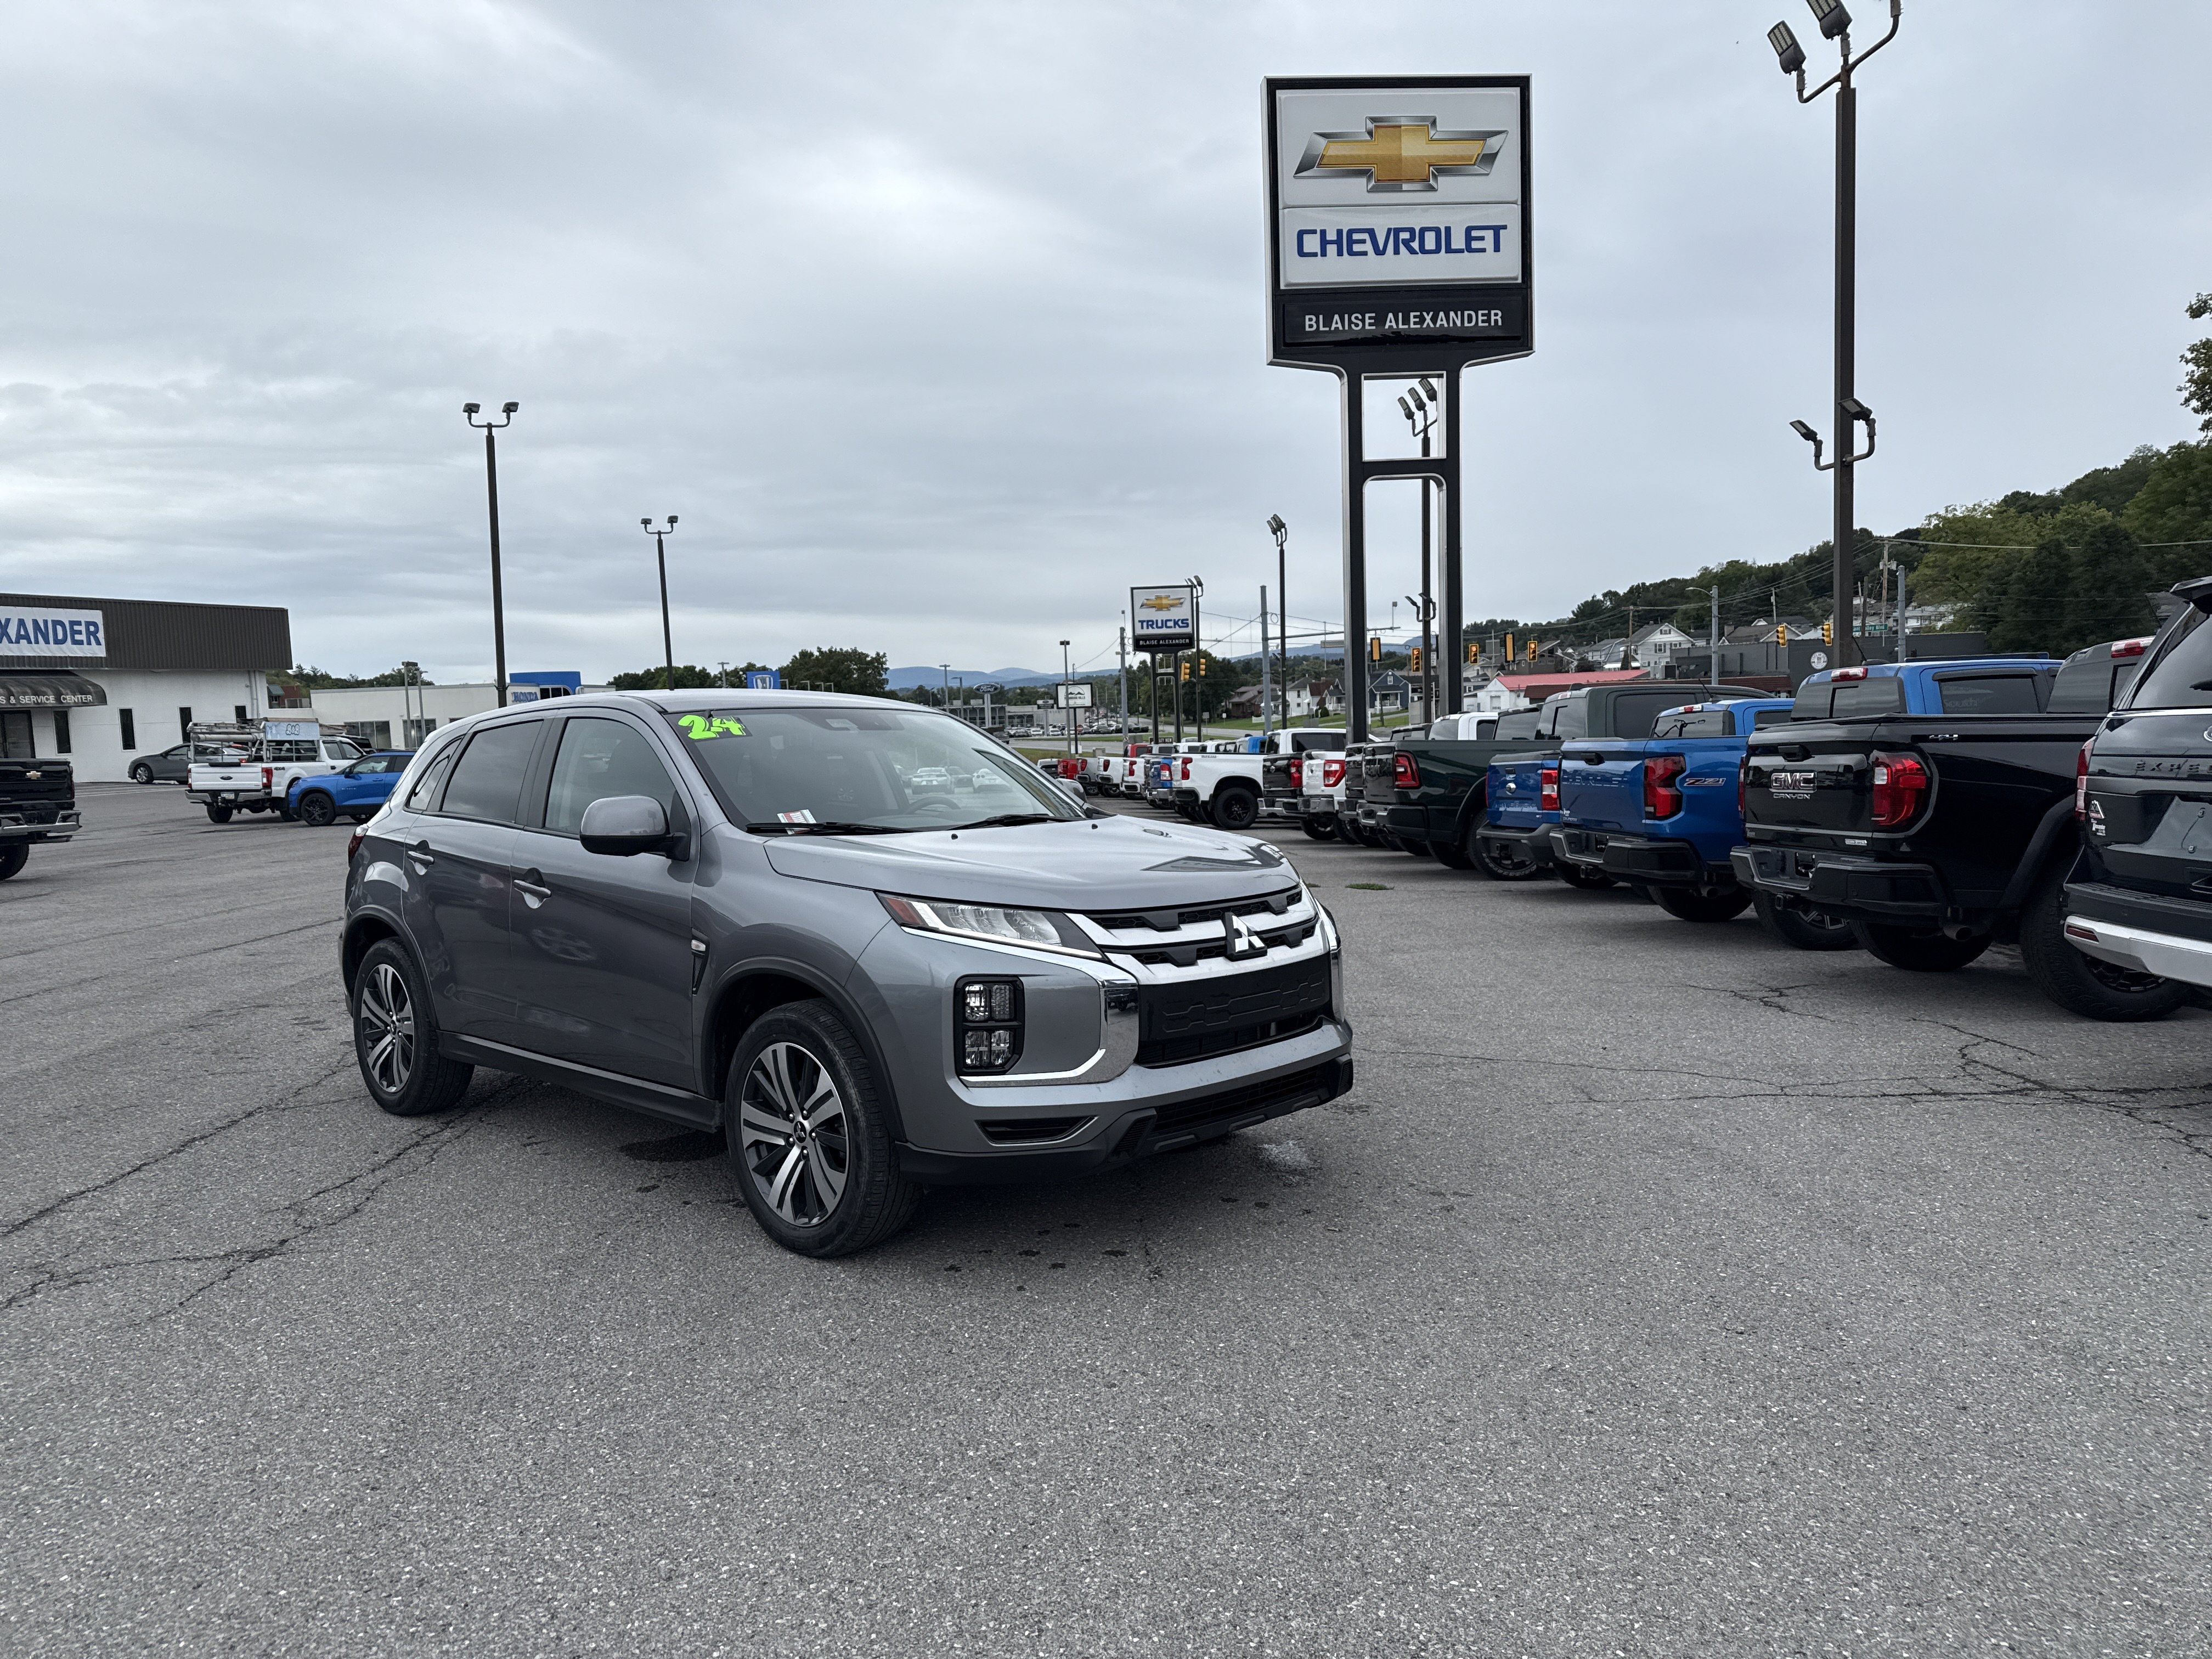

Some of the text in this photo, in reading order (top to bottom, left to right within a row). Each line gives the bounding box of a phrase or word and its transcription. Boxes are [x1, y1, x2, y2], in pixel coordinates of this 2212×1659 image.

[1297, 224, 1508, 257] CHEVROLET
[1305, 309, 1503, 331] BLAISE ALEXANDER
[0, 617, 102, 646] XANDER
[1138, 618, 1189, 630] TRUCKS
[9, 696, 16, 704] &
[19, 695, 56, 704] SERVICE
[60, 695, 93, 703] CENTER
[511, 691, 539, 702] HONDA
[678, 714, 747, 740] 24
[1683, 777, 1726, 787] Z71
[1771, 772, 1815, 789] GMC
